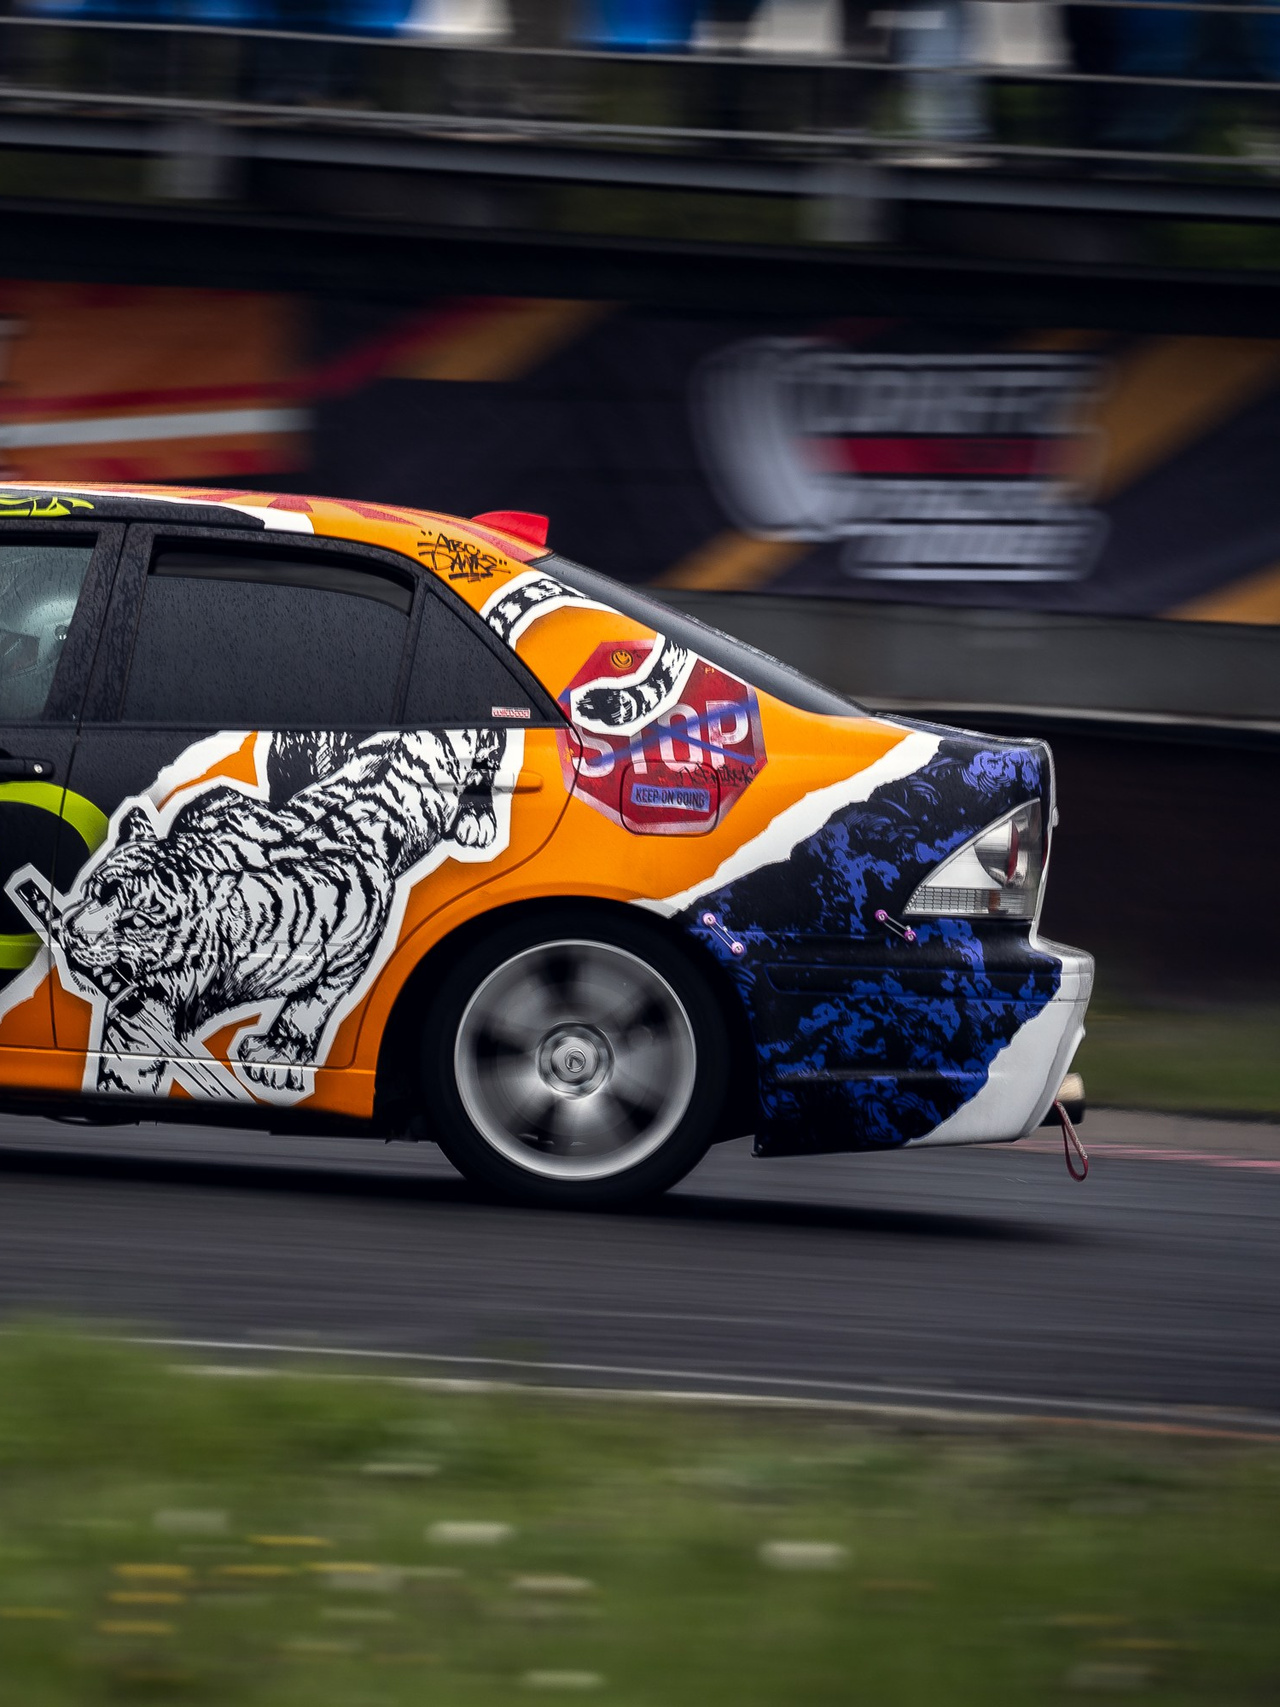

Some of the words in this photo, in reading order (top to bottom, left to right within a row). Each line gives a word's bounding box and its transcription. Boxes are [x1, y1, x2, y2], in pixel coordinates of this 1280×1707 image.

[635, 787, 659, 804] KEEP
[661, 789, 674, 805] ON
[676, 790, 705, 809] GOING
